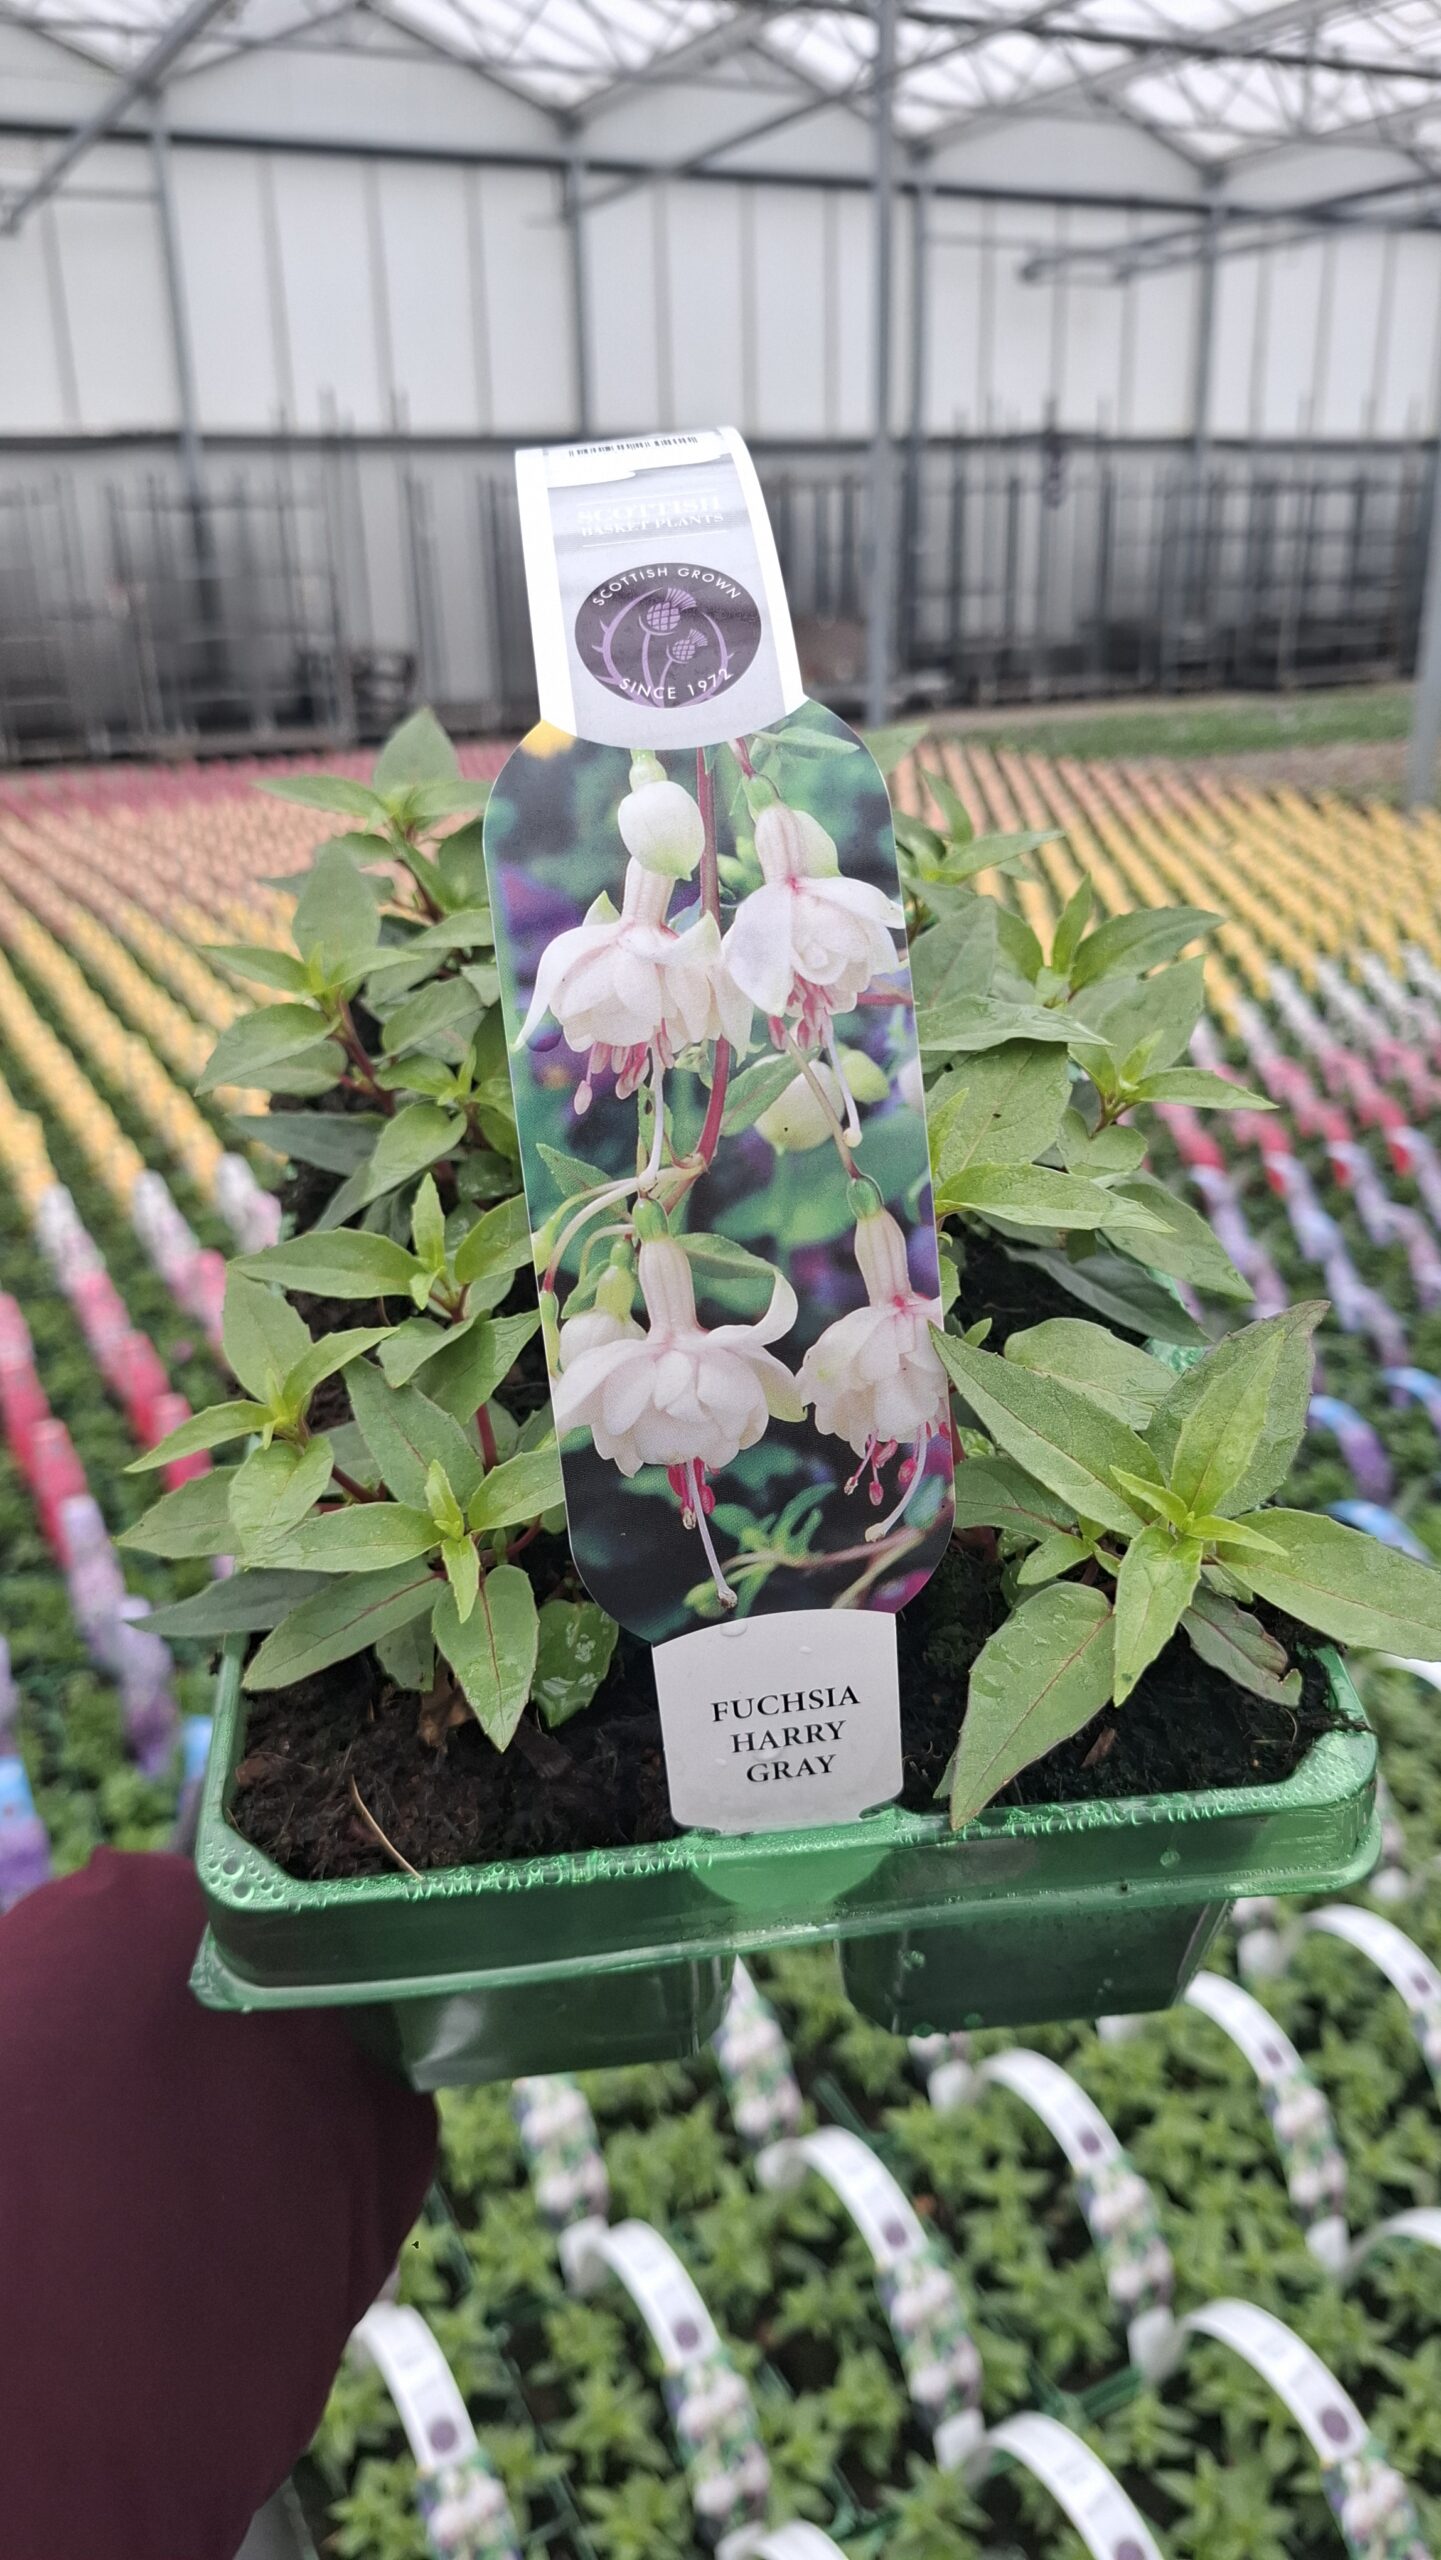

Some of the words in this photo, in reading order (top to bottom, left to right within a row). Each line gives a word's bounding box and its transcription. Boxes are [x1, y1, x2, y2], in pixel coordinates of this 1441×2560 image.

[577, 496, 722, 524] SCOTTISH
[580, 518, 651, 537] BASKET
[654, 513, 724, 530] PLANTS
[592, 567, 668, 606] SCOTTISH
[678, 567, 741, 599] GROWN
[619, 678, 677, 699] SINCE
[688, 668, 734, 697] 1972
[712, 1685, 860, 1722] FUCHSIA
[731, 1720, 846, 1753] HARRY
[746, 1755, 836, 1782] GRAY
